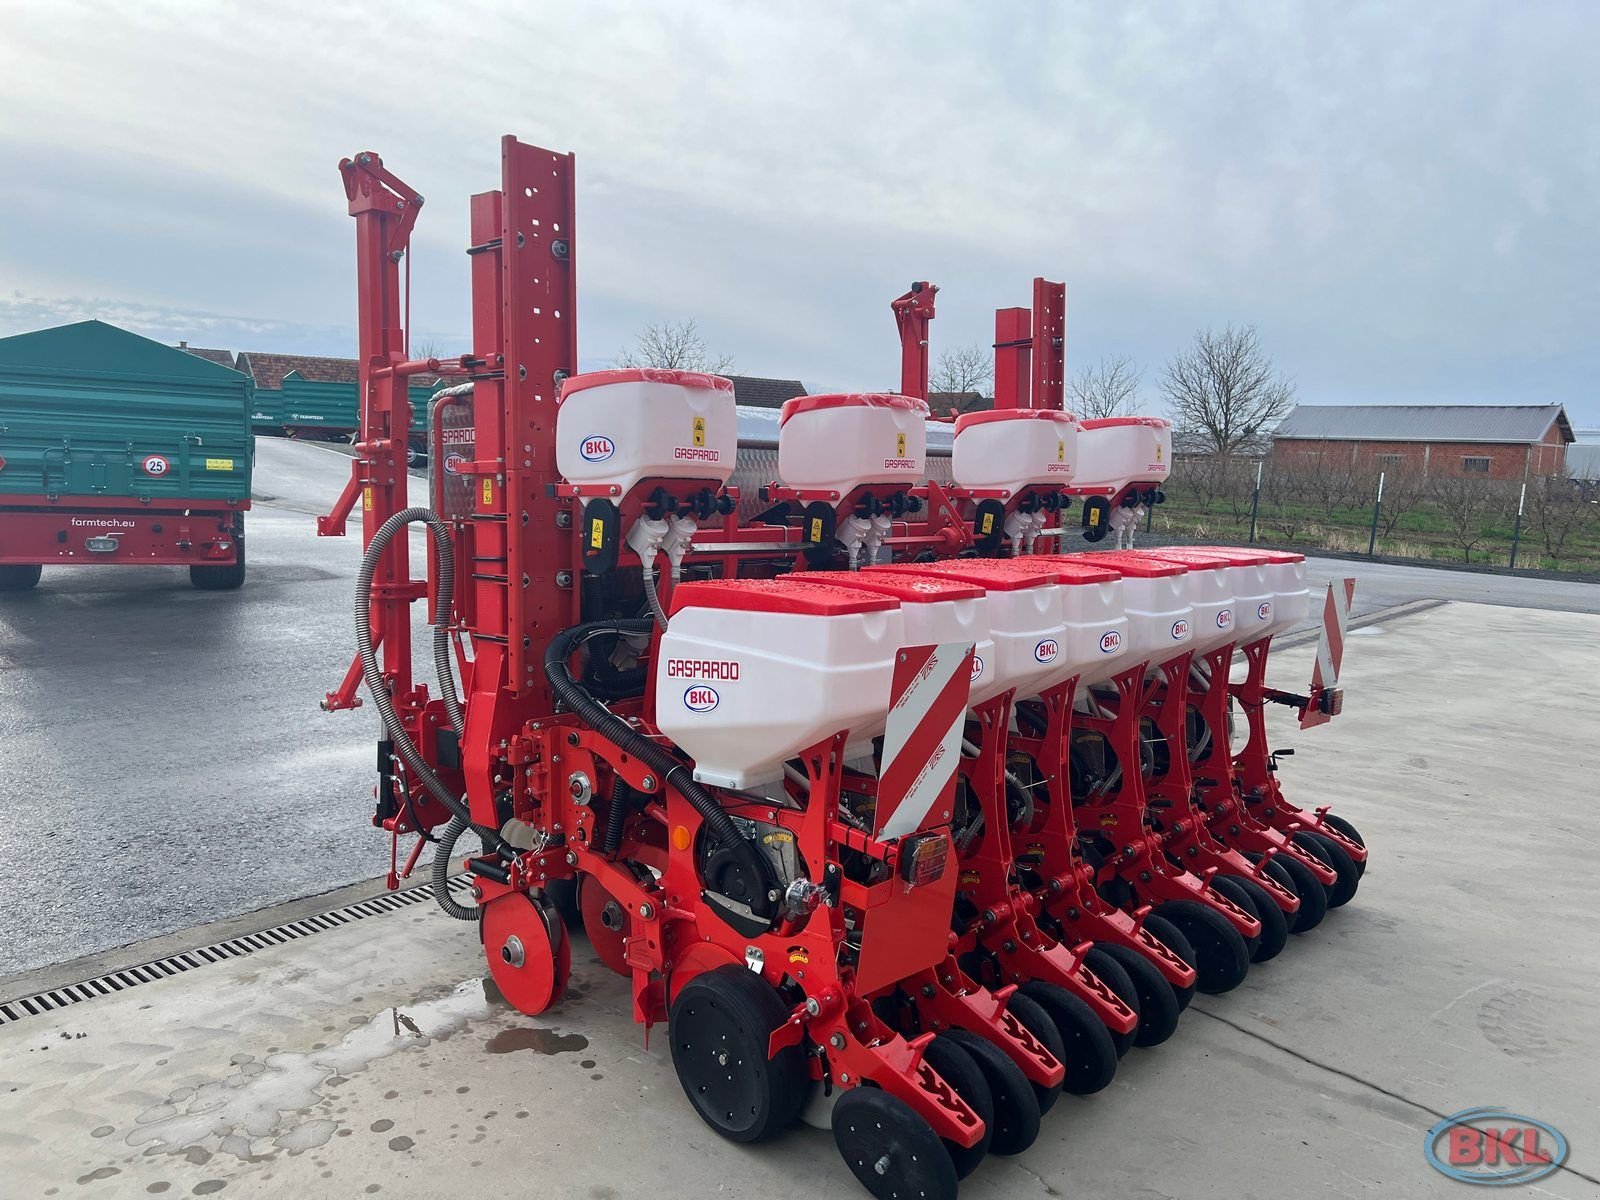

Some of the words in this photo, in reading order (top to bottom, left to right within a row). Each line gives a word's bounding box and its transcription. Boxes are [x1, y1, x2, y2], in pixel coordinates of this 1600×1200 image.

[586, 441, 610, 454] BKL
[674, 448, 719, 462] GASPARDO
[150, 461, 163, 472] 25
[885, 459, 916, 469] GASPARDO
[71, 517, 135, 528] farmtech.eu
[1175, 624, 1186, 635] BKL
[1104, 635, 1119, 648] BKL
[1039, 643, 1056, 657] BKL
[668, 659, 739, 680] GASPARDO
[690, 691, 715, 703] BKL
